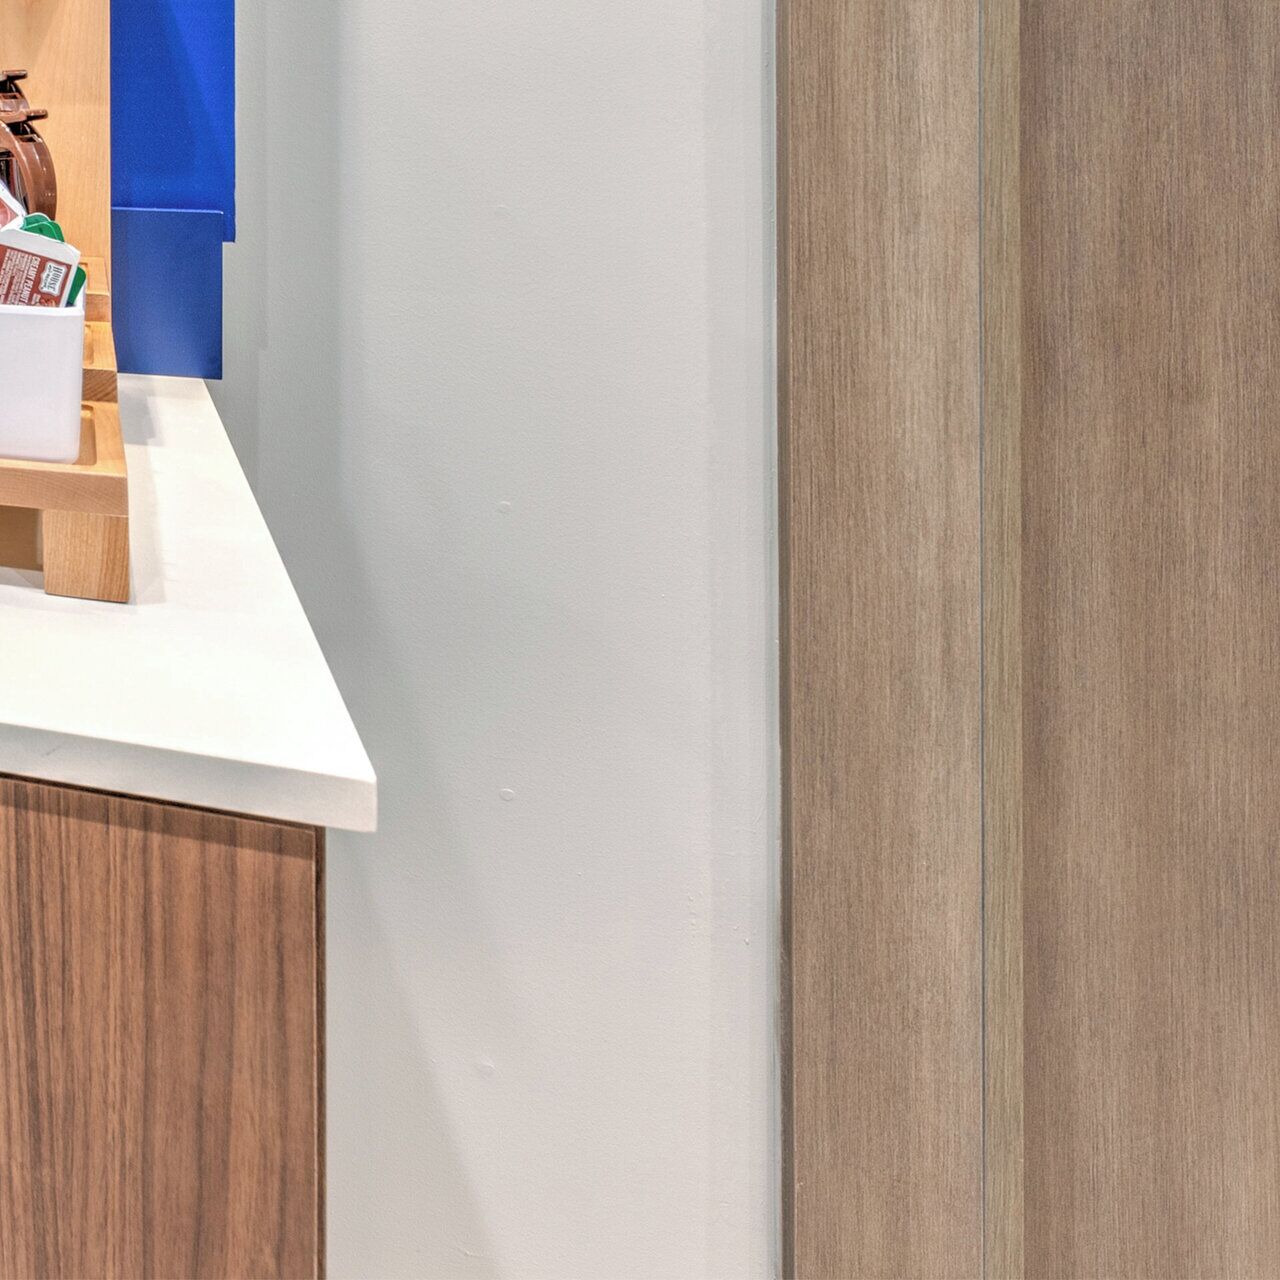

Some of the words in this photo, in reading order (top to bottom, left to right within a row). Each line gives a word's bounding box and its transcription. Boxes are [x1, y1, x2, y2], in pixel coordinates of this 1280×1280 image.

[26, 255, 40, 280] CREAMY
[46, 265, 63, 292] HOUSE
[18, 278, 33, 302] PEANUT
